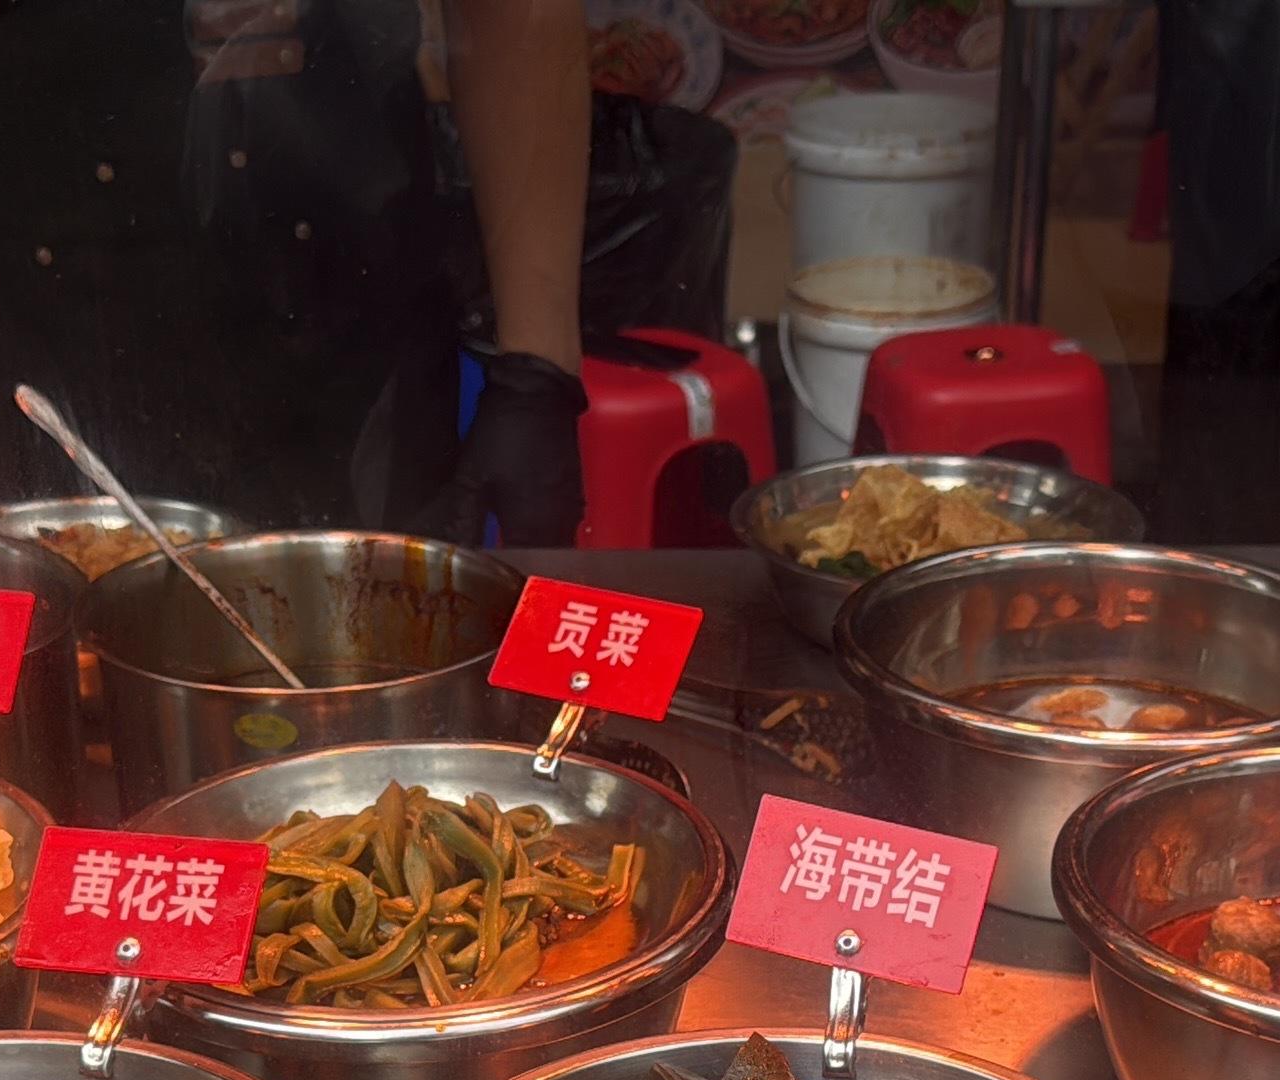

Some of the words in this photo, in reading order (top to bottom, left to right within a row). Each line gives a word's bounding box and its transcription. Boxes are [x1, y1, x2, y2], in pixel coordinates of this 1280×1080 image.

[547, 601, 650, 668] 贡菜
[64, 849, 225, 927] 黄花菜
[779, 823, 952, 929] 海带结
